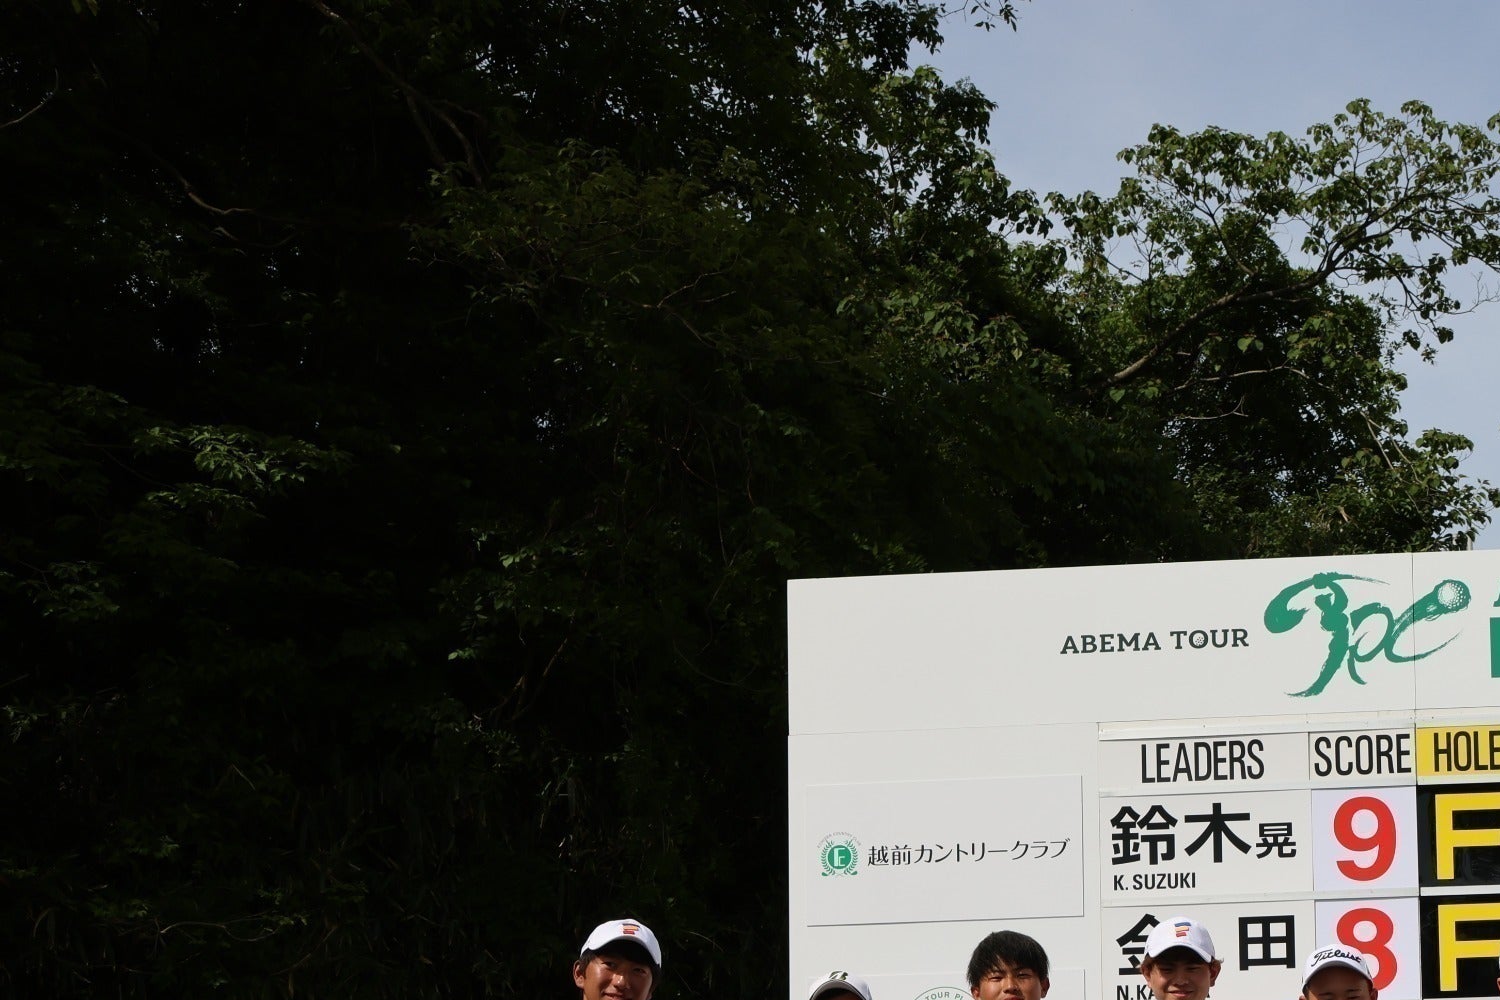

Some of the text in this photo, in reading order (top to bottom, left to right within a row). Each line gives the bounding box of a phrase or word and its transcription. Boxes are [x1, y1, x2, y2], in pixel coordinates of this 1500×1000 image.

[1060, 628, 1250, 654] ABEMA TOUR
[1141, 739, 1265, 784] LEADERS
[1314, 734, 1412, 777] SCORE
[867, 836, 1071, 867] 越前カントリークラブ
[1110, 802, 1297, 866] 鈴木晃
[1333, 796, 1397, 882] 9
[1311, 949, 1361, 967] Titleist
[1336, 908, 1398, 991] 8
